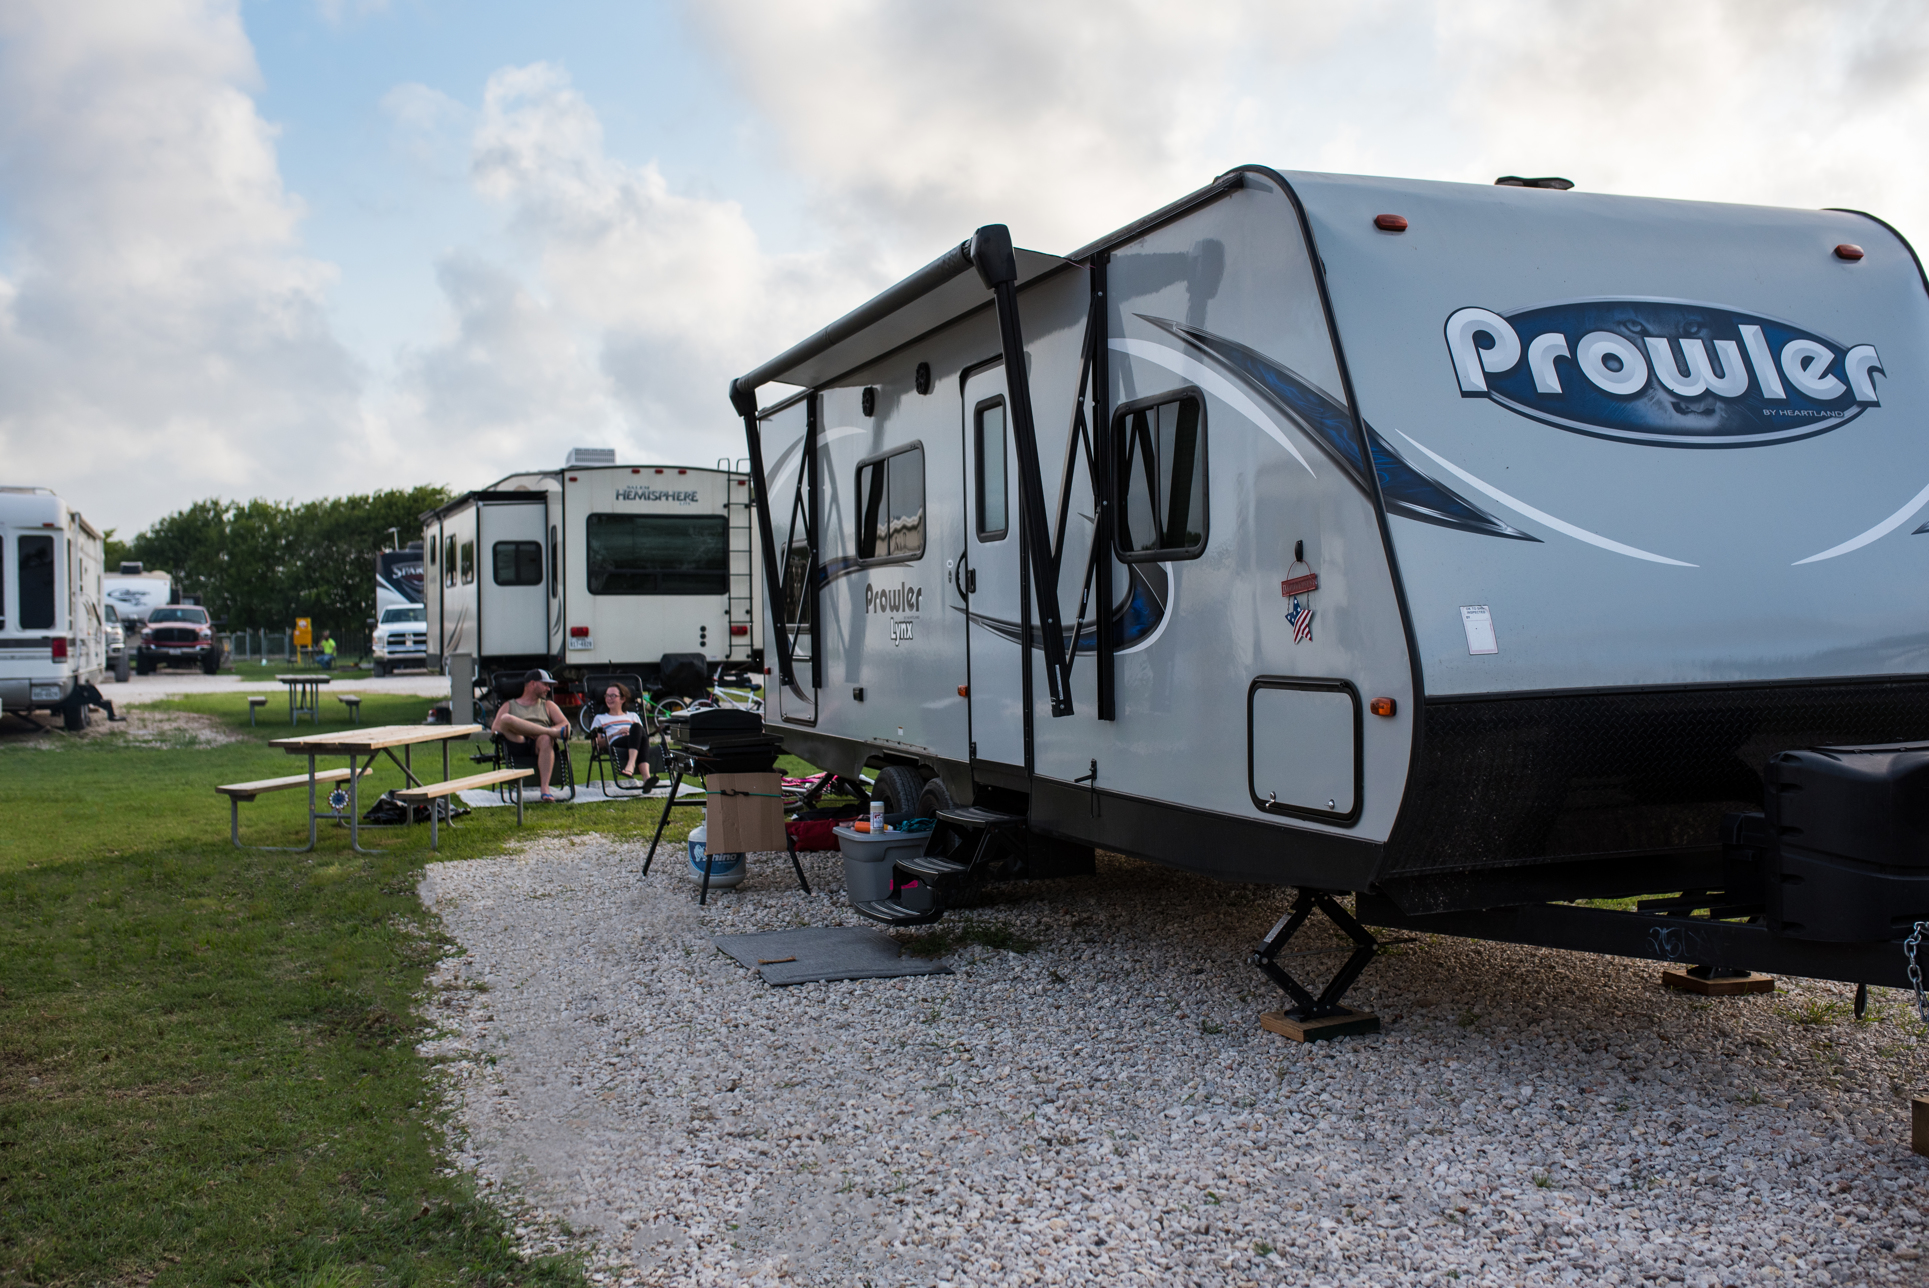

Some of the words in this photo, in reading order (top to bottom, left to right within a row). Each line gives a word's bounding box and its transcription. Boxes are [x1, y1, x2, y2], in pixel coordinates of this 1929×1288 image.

[1443, 306, 1887, 408] Prowler
[1762, 408, 1777, 416] BY
[1778, 409, 1845, 418] HEARTLAND
[615, 489, 699, 502] HEMISPHERE
[865, 581, 922, 614] Prowler
[890, 616, 914, 647] Lynx
